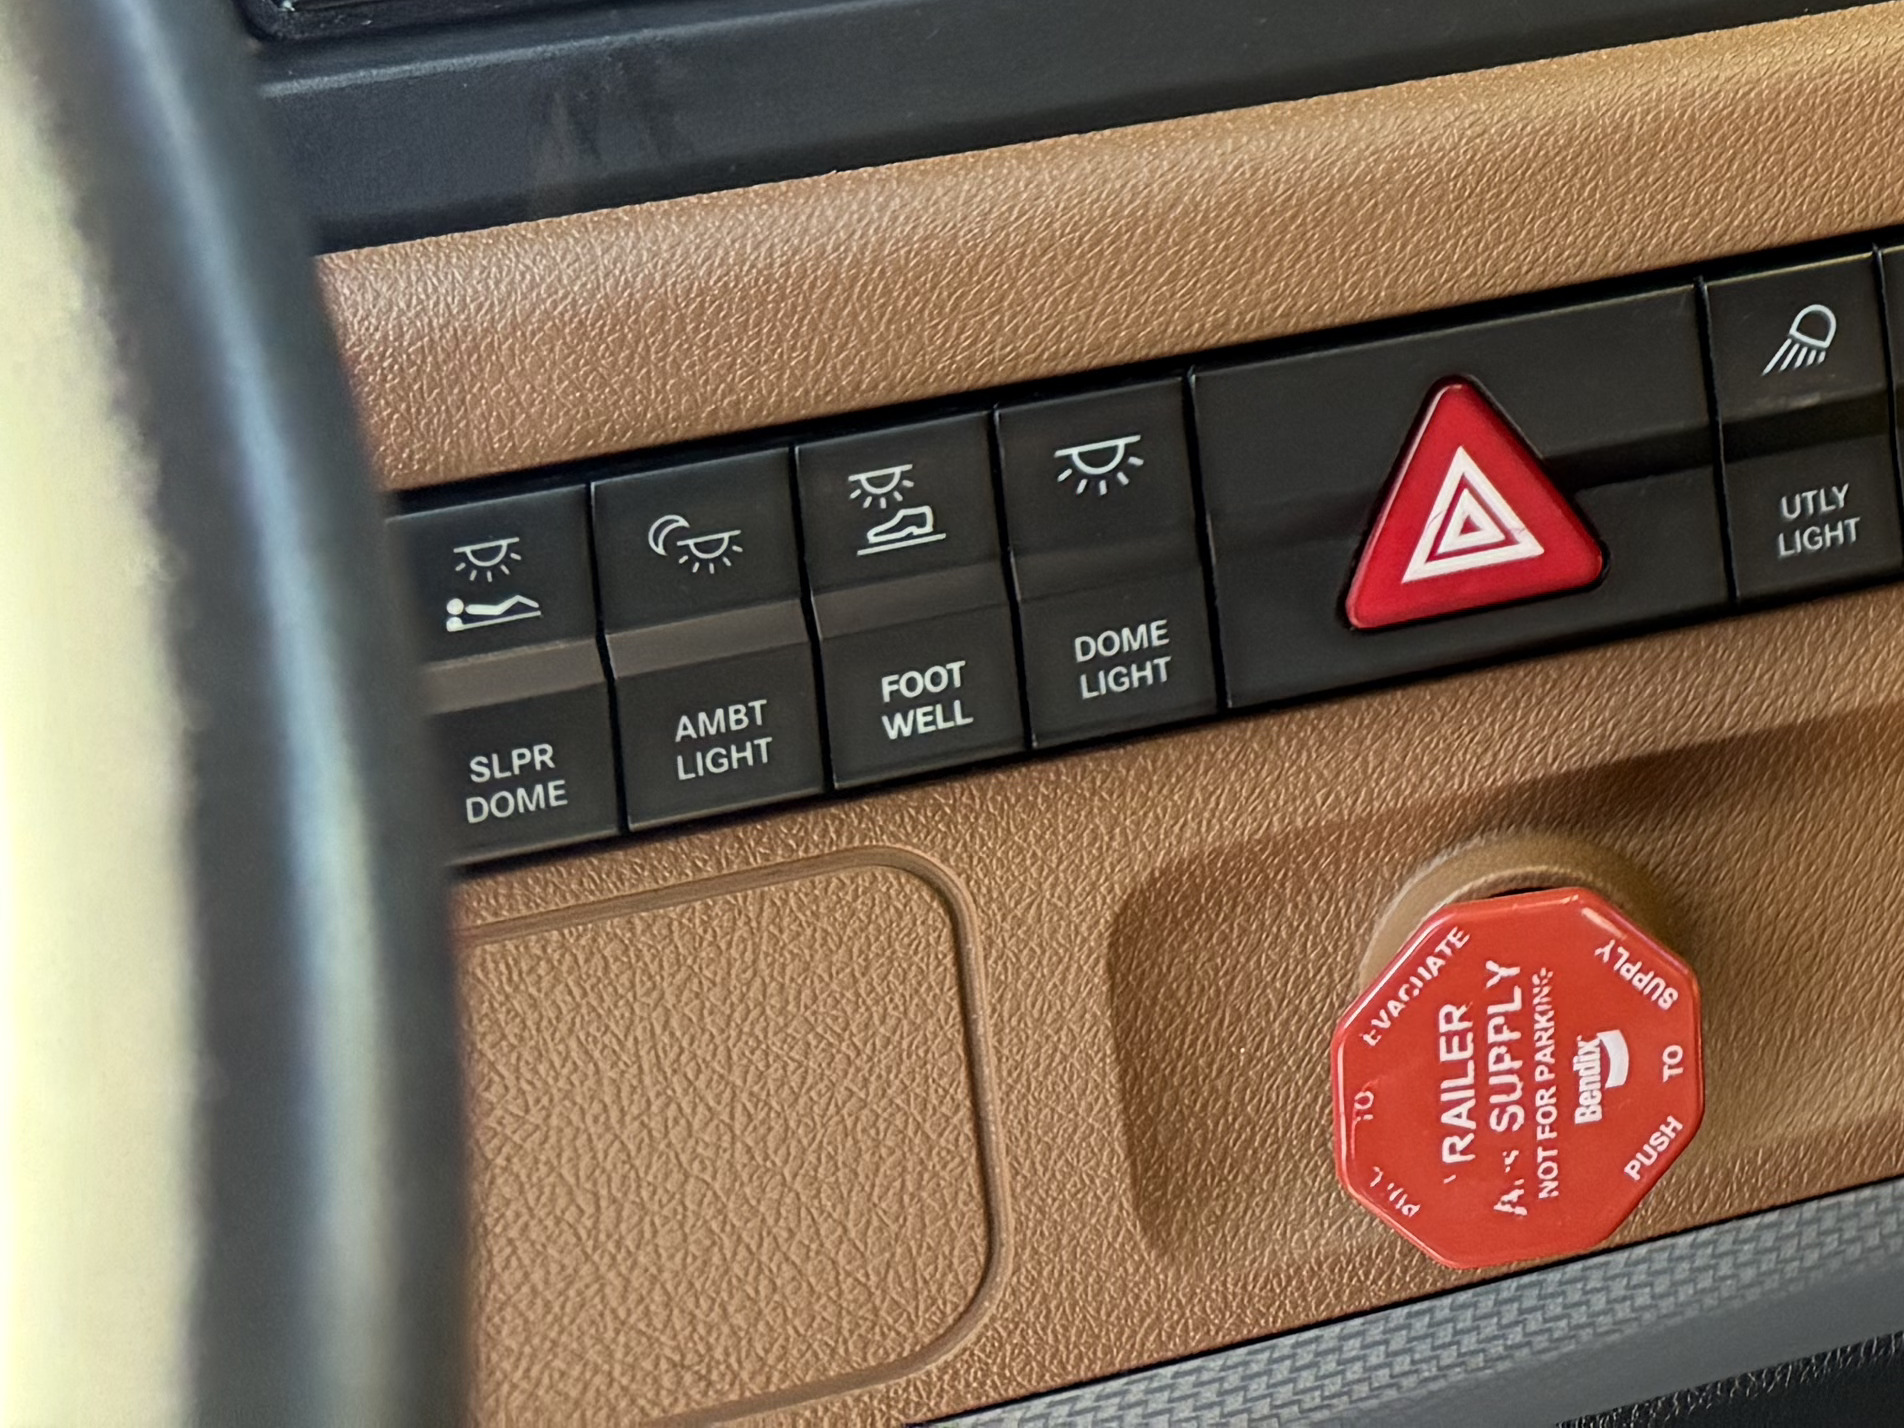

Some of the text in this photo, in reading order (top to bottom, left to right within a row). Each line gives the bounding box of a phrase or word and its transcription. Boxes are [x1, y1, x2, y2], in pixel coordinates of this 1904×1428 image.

[1779, 483, 1851, 521] UTLY
[1777, 517, 1862, 559] LIGHT
[1073, 618, 1171, 664] DOME
[880, 660, 968, 704] FOOT
[1079, 655, 1173, 701] LIGHT
[674, 699, 768, 743] AMBT
[881, 698, 974, 741] WELL
[468, 743, 556, 784] SLPR
[675, 736, 774, 782] LIGHT
[465, 779, 569, 825] DOME
[1485, 959, 1526, 1133] SUPPLY
[1594, 939, 1684, 1182] PUSH TO SUPPLY
[1572, 1036, 1603, 1125] Bendix
[1534, 1085, 1558, 1142] FOR
[1536, 1148, 1560, 1200] NOT
